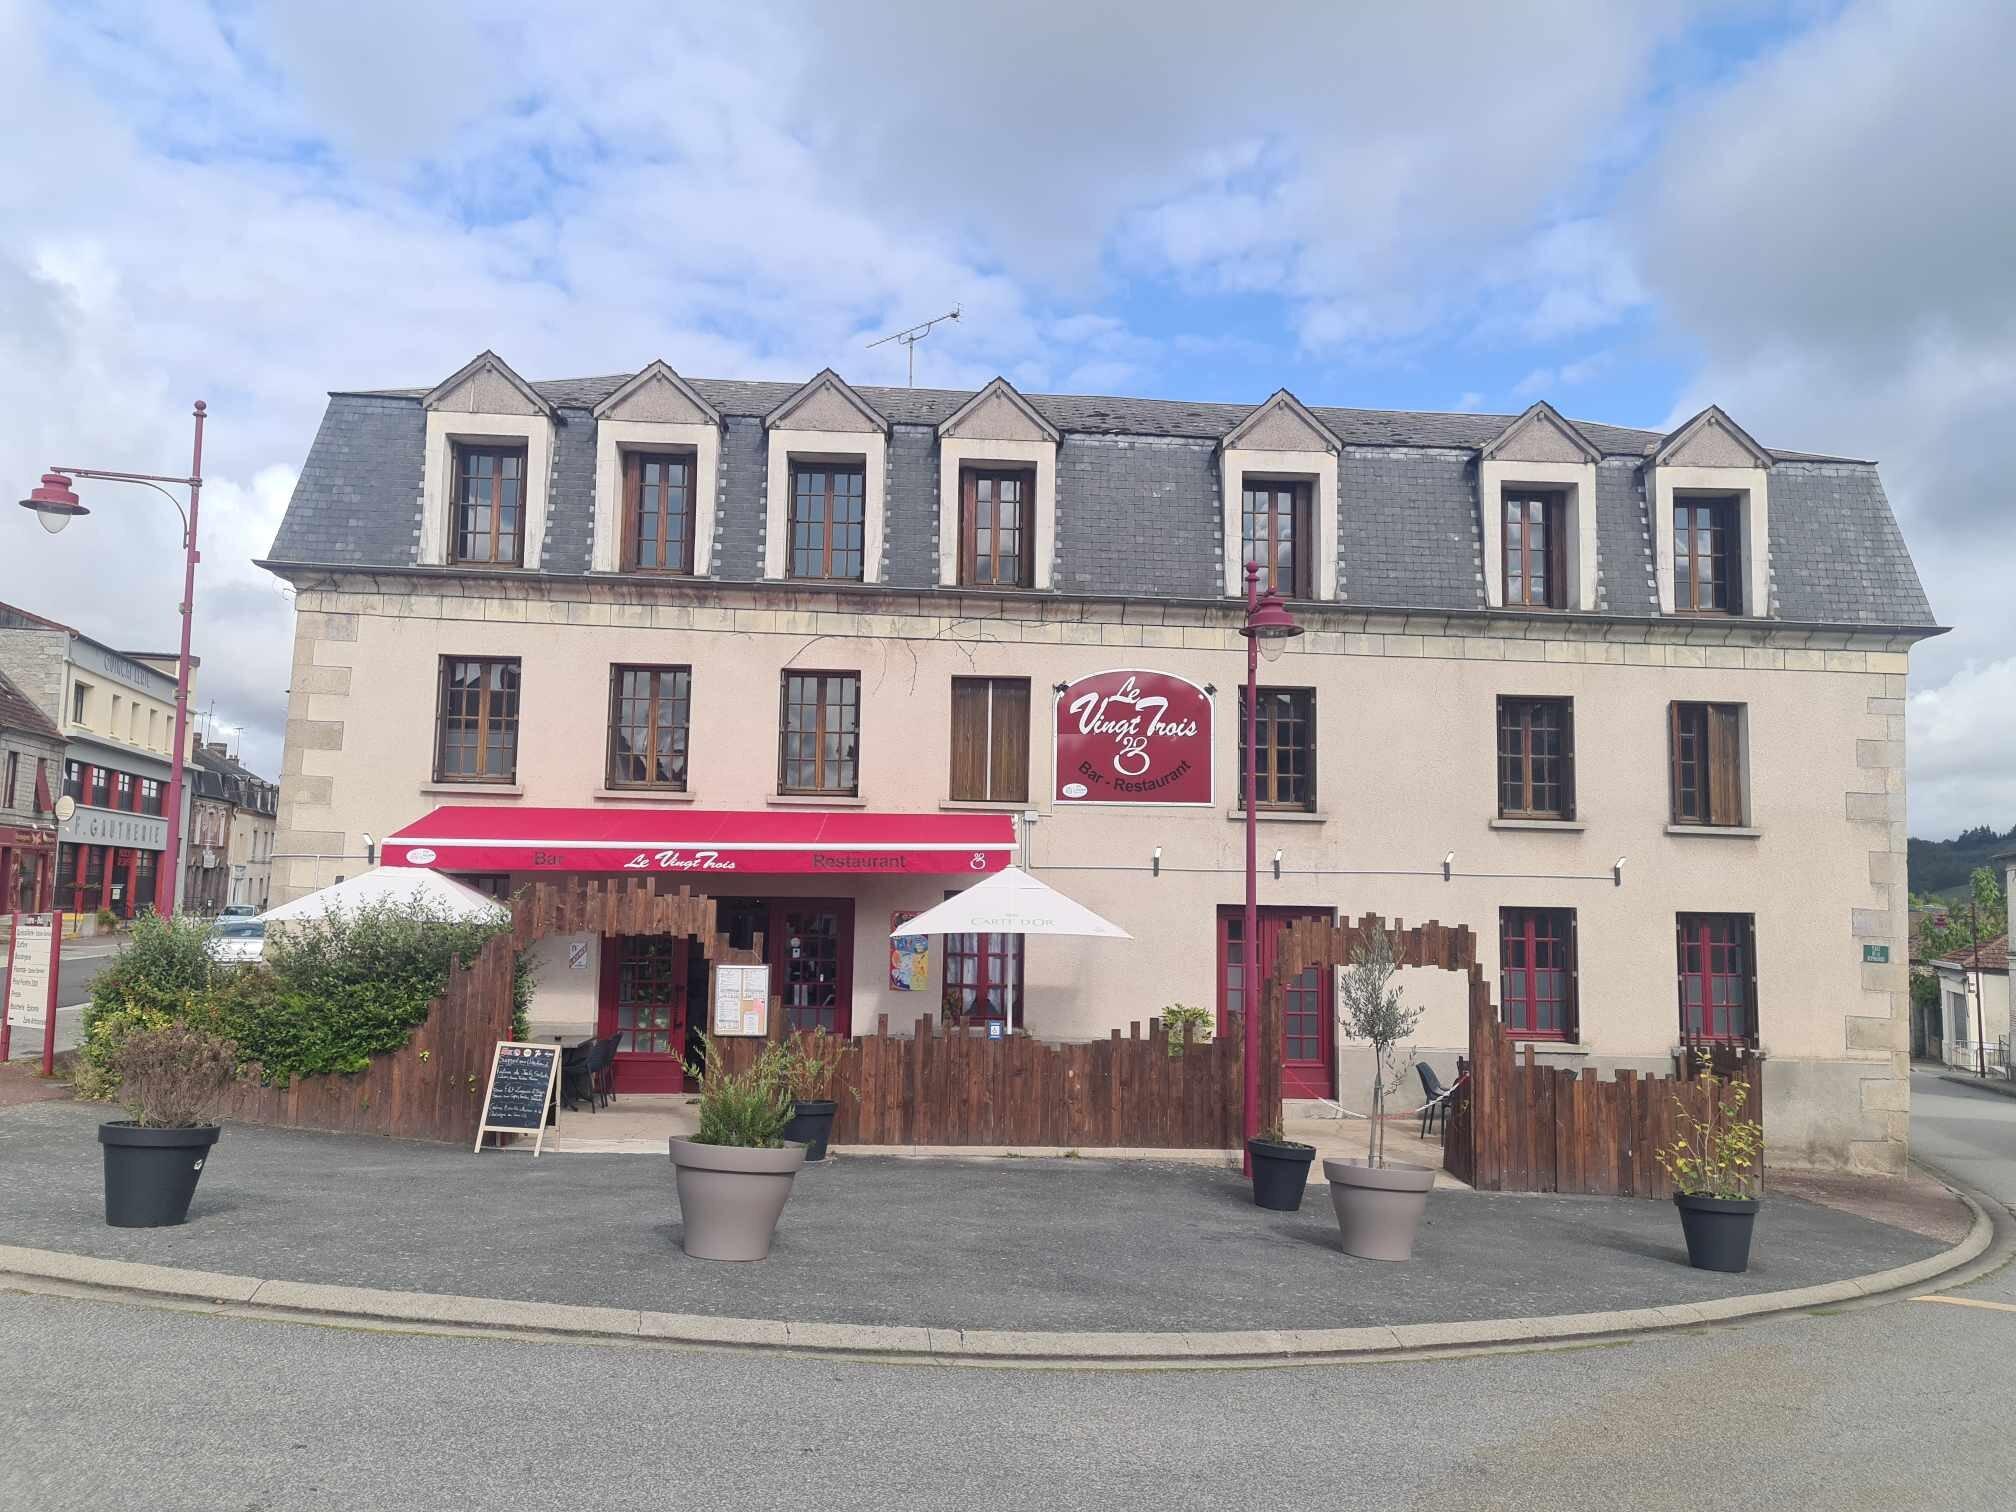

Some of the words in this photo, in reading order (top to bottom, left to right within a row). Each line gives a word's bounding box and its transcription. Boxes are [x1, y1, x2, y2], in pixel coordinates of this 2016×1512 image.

[1108, 675, 1141, 704] Le
[1069, 692, 1142, 742] Vingt
[1135, 696, 1197, 737] Trois
[1077, 760, 1105, 783] Bar
[1113, 759, 1192, 793] Restaurant
[534, 851, 565, 866] Bar
[623, 852, 650, 869] Le
[654, 849, 702, 870] Vingt
[697, 851, 737, 870] Trois
[813, 854, 907, 868] Restaurant
